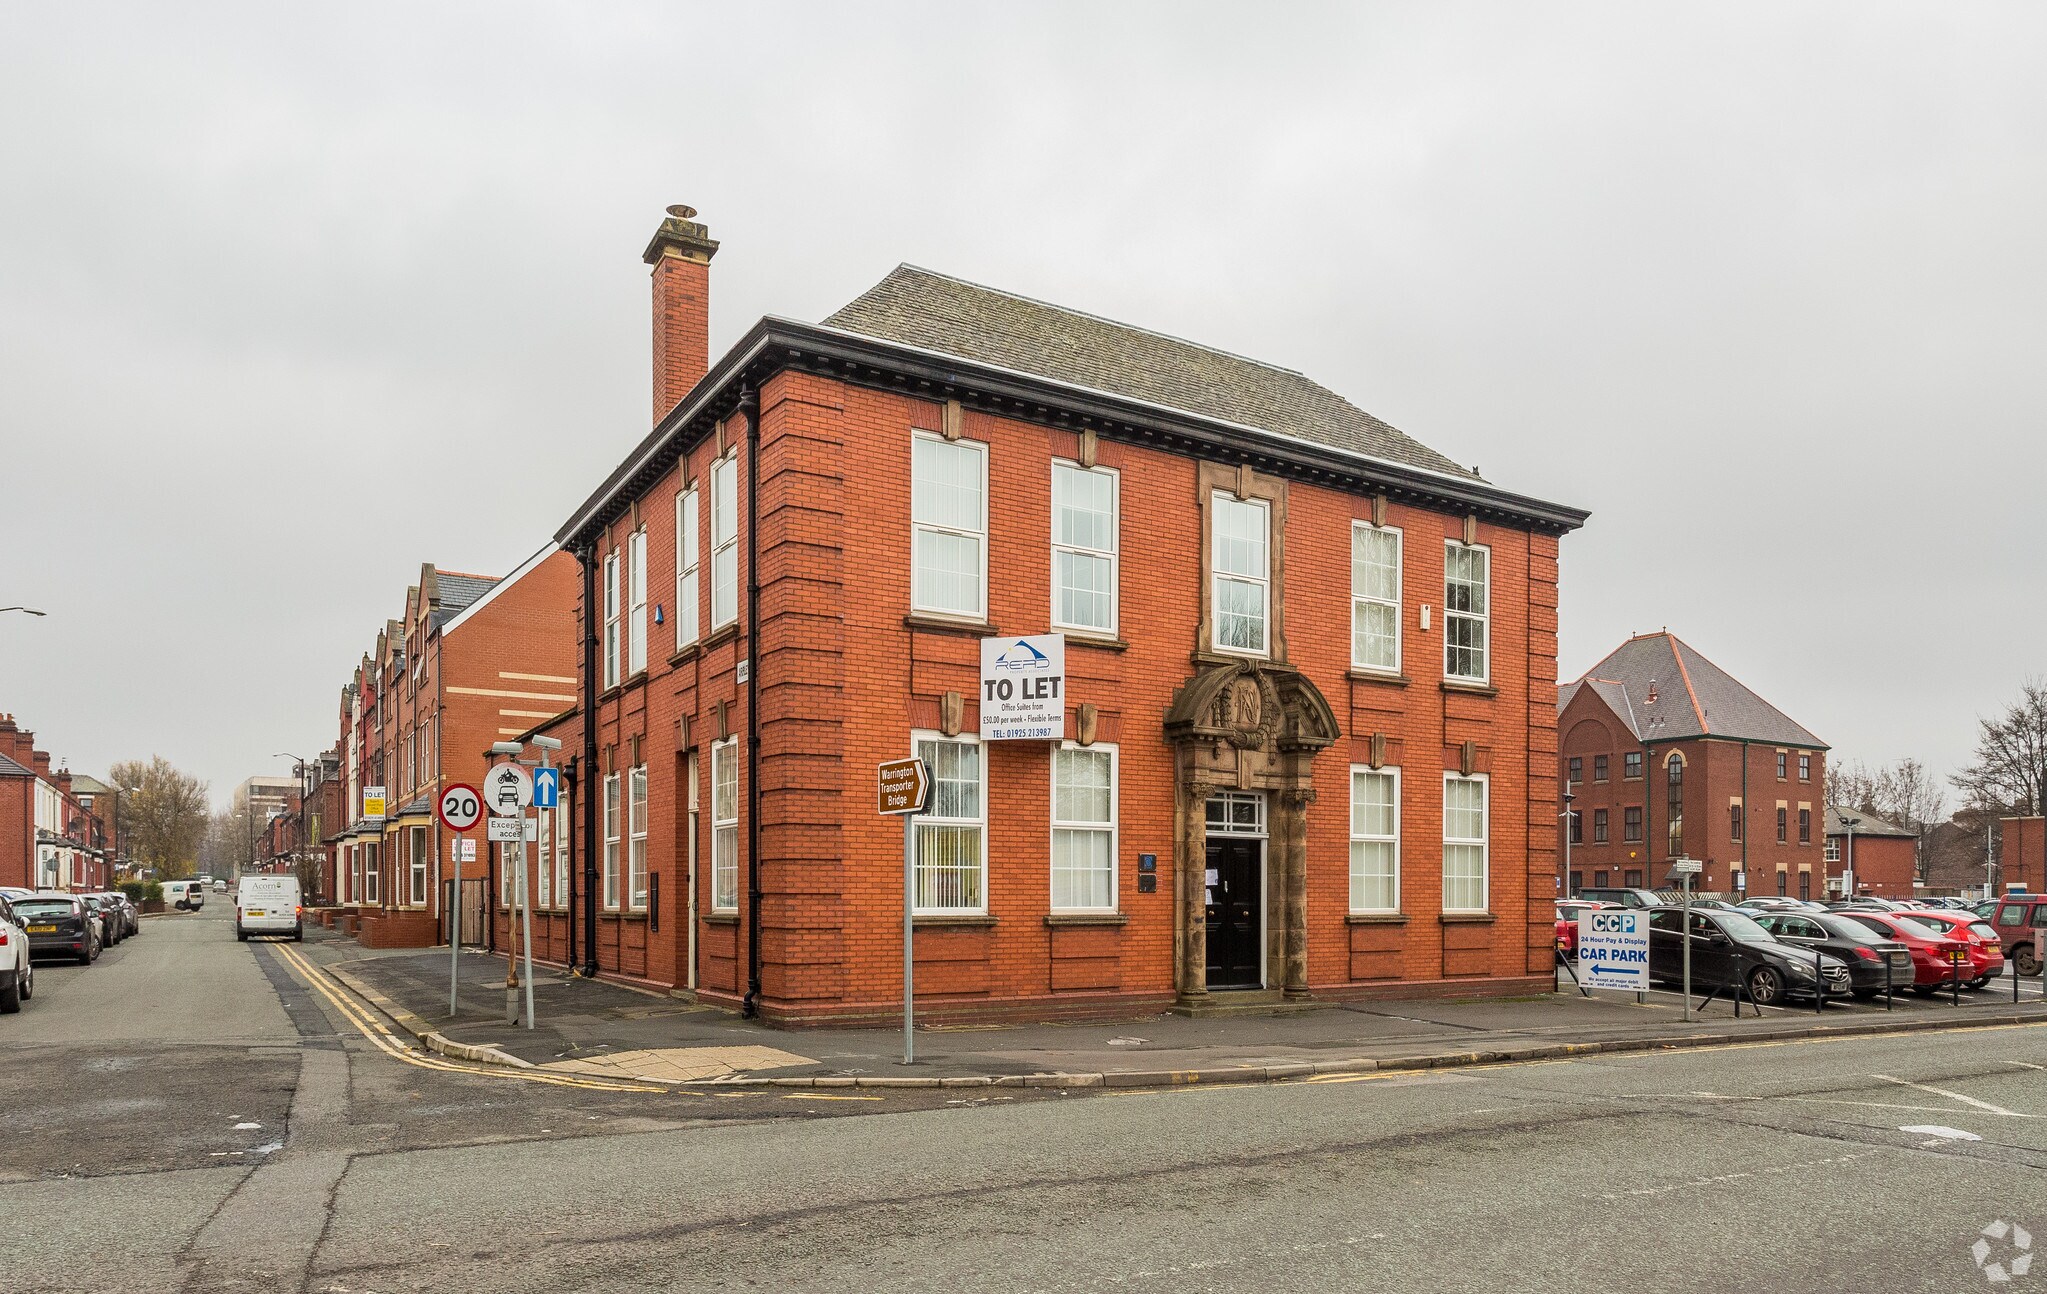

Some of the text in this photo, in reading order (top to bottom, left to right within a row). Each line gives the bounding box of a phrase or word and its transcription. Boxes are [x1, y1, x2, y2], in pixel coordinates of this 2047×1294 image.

[984, 676, 1061, 701] TO LET
[1001, 703, 1016, 711] Office
[1016, 702, 1031, 710] Suites
[983, 716, 1000, 724] £50.00
[1000, 716, 1008, 725] per
[1010, 715, 1023, 723] week
[1028, 714, 1046, 722] Flexible
[1048, 714, 1062, 722] Terms
[993, 728, 1052, 738] TEL: 01925 213987
[882, 767, 914, 780] Warrington
[880, 780, 914, 794] Transporter
[888, 794, 908, 806] Bridge
[446, 798, 477, 817] 20
[491, 820, 517, 830] Excep
[1592, 915, 1635, 932] CCP
[1580, 948, 1648, 962] CAR PARK
